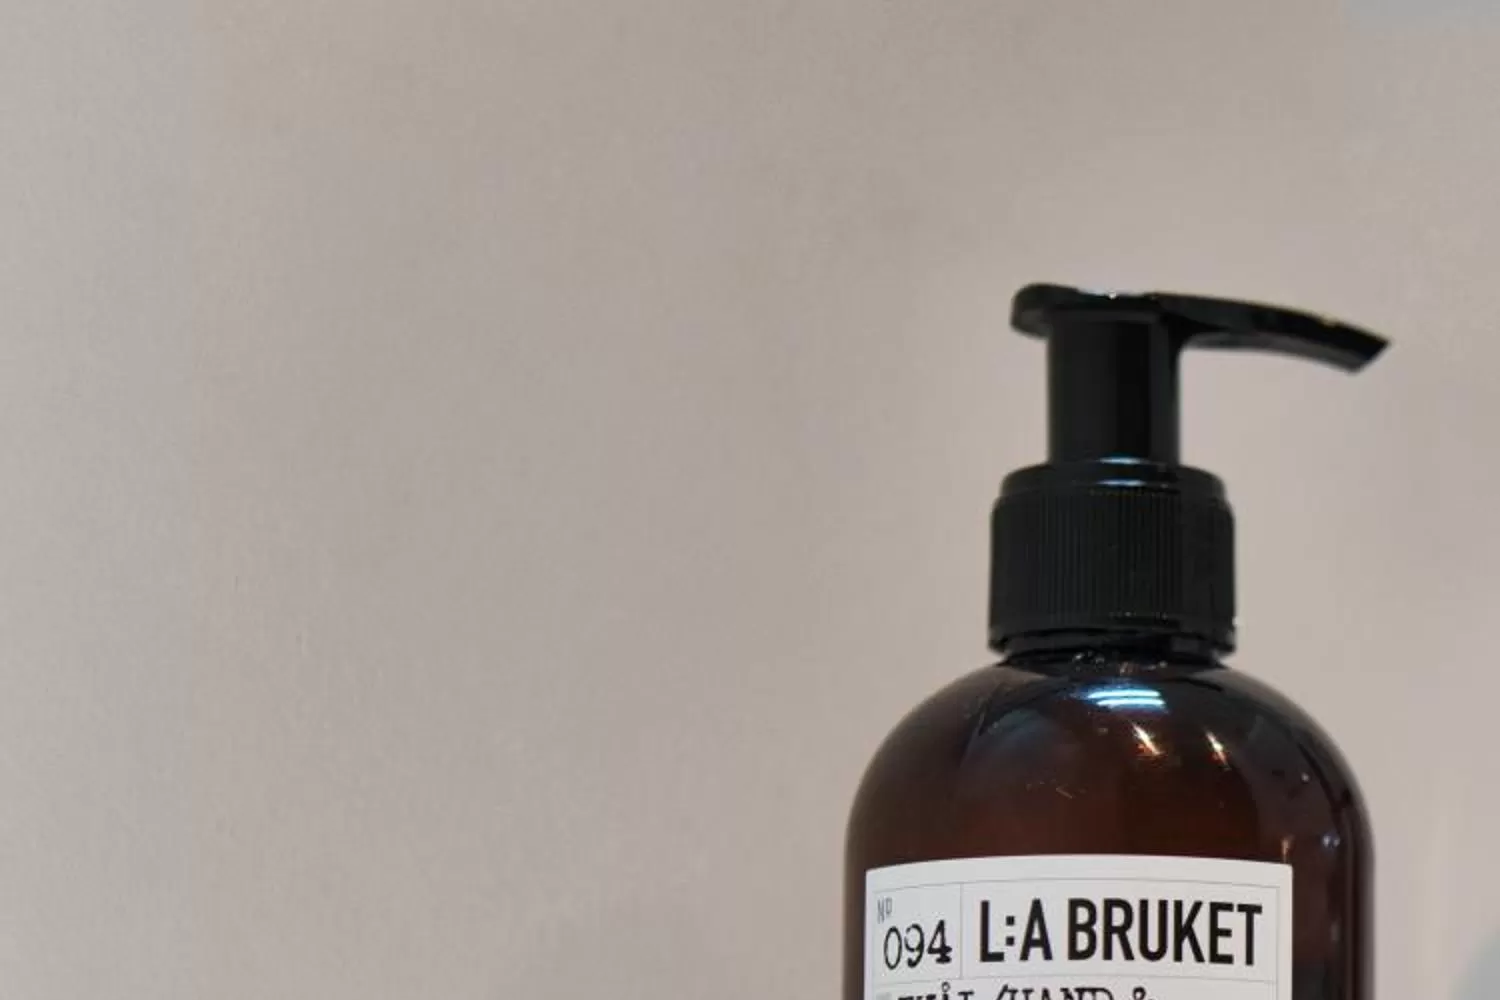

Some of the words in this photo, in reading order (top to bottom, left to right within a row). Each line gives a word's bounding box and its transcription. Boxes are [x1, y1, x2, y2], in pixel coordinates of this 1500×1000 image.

[884, 919, 952, 970] 094
[980, 898, 1052, 962] L:A
[1067, 898, 1262, 966] BRUKET
